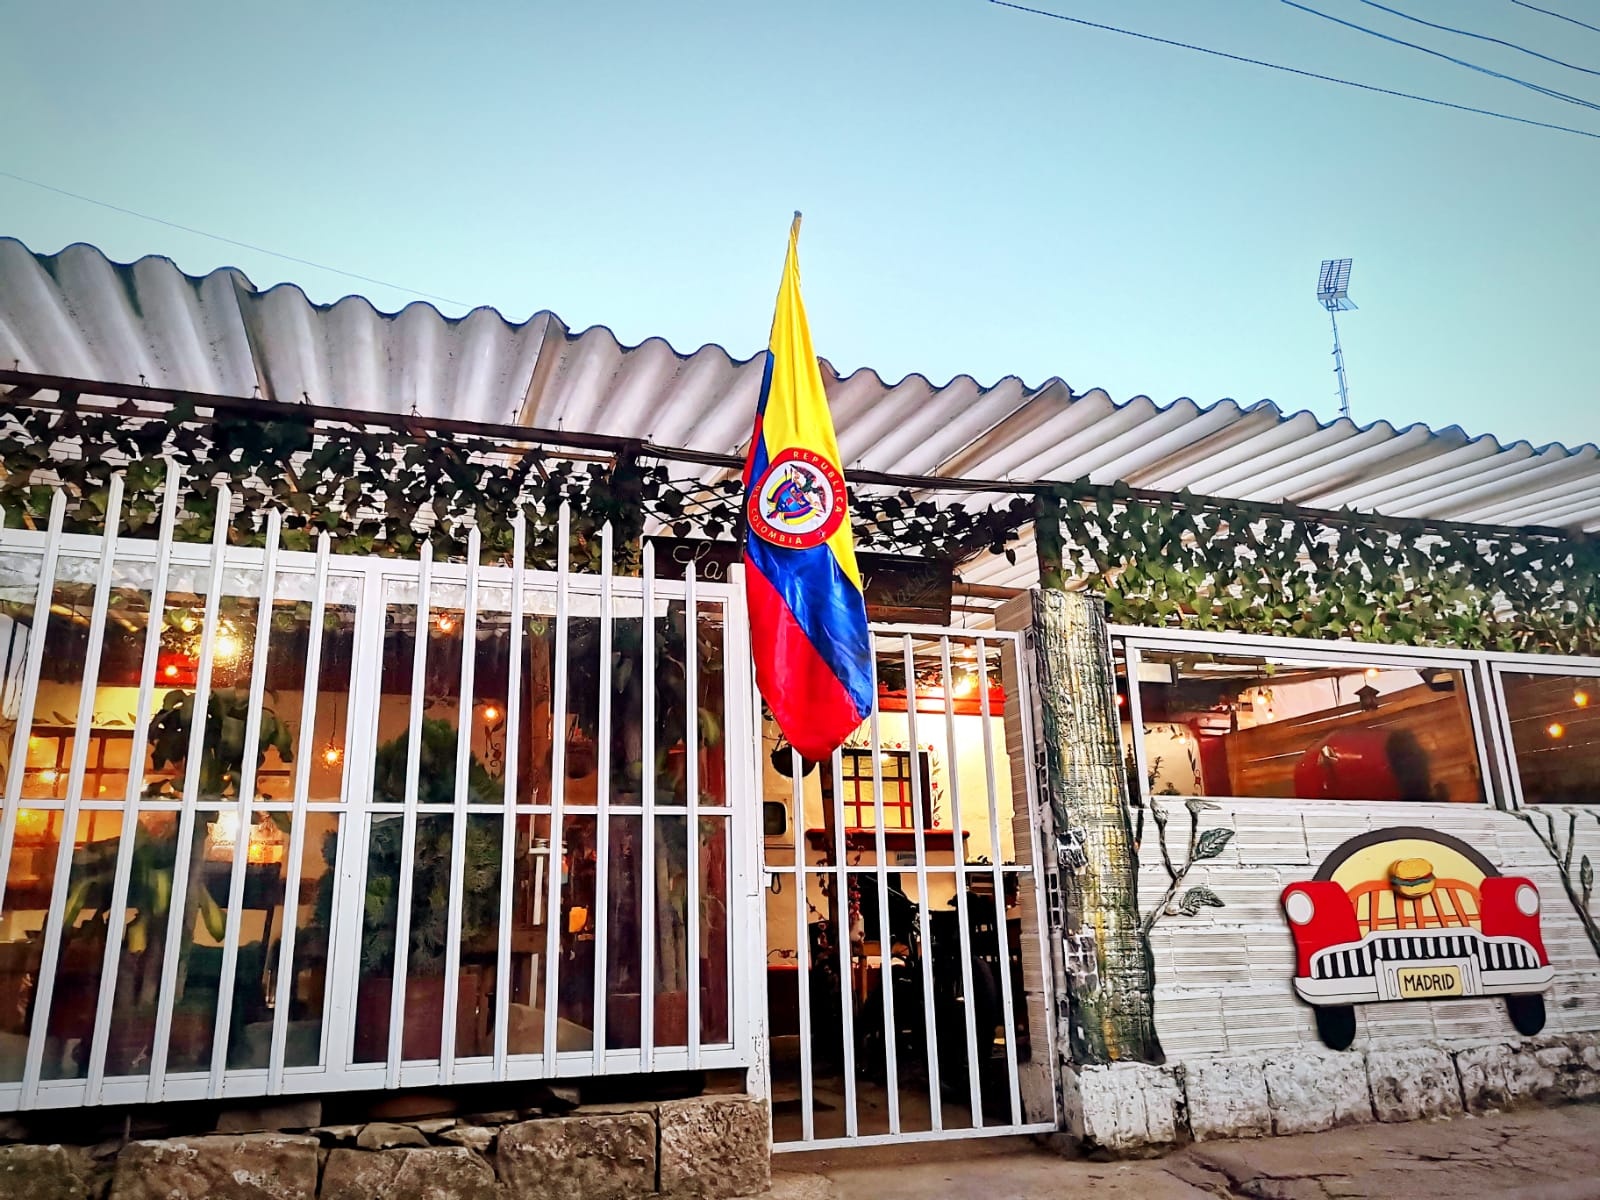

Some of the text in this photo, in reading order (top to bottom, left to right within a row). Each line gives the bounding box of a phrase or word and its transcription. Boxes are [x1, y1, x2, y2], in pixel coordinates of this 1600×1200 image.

[793, 451, 843, 513] REPUBLICA
[751, 508, 802, 544] COLOMBIA
[1403, 973, 1455, 991] MADRID
